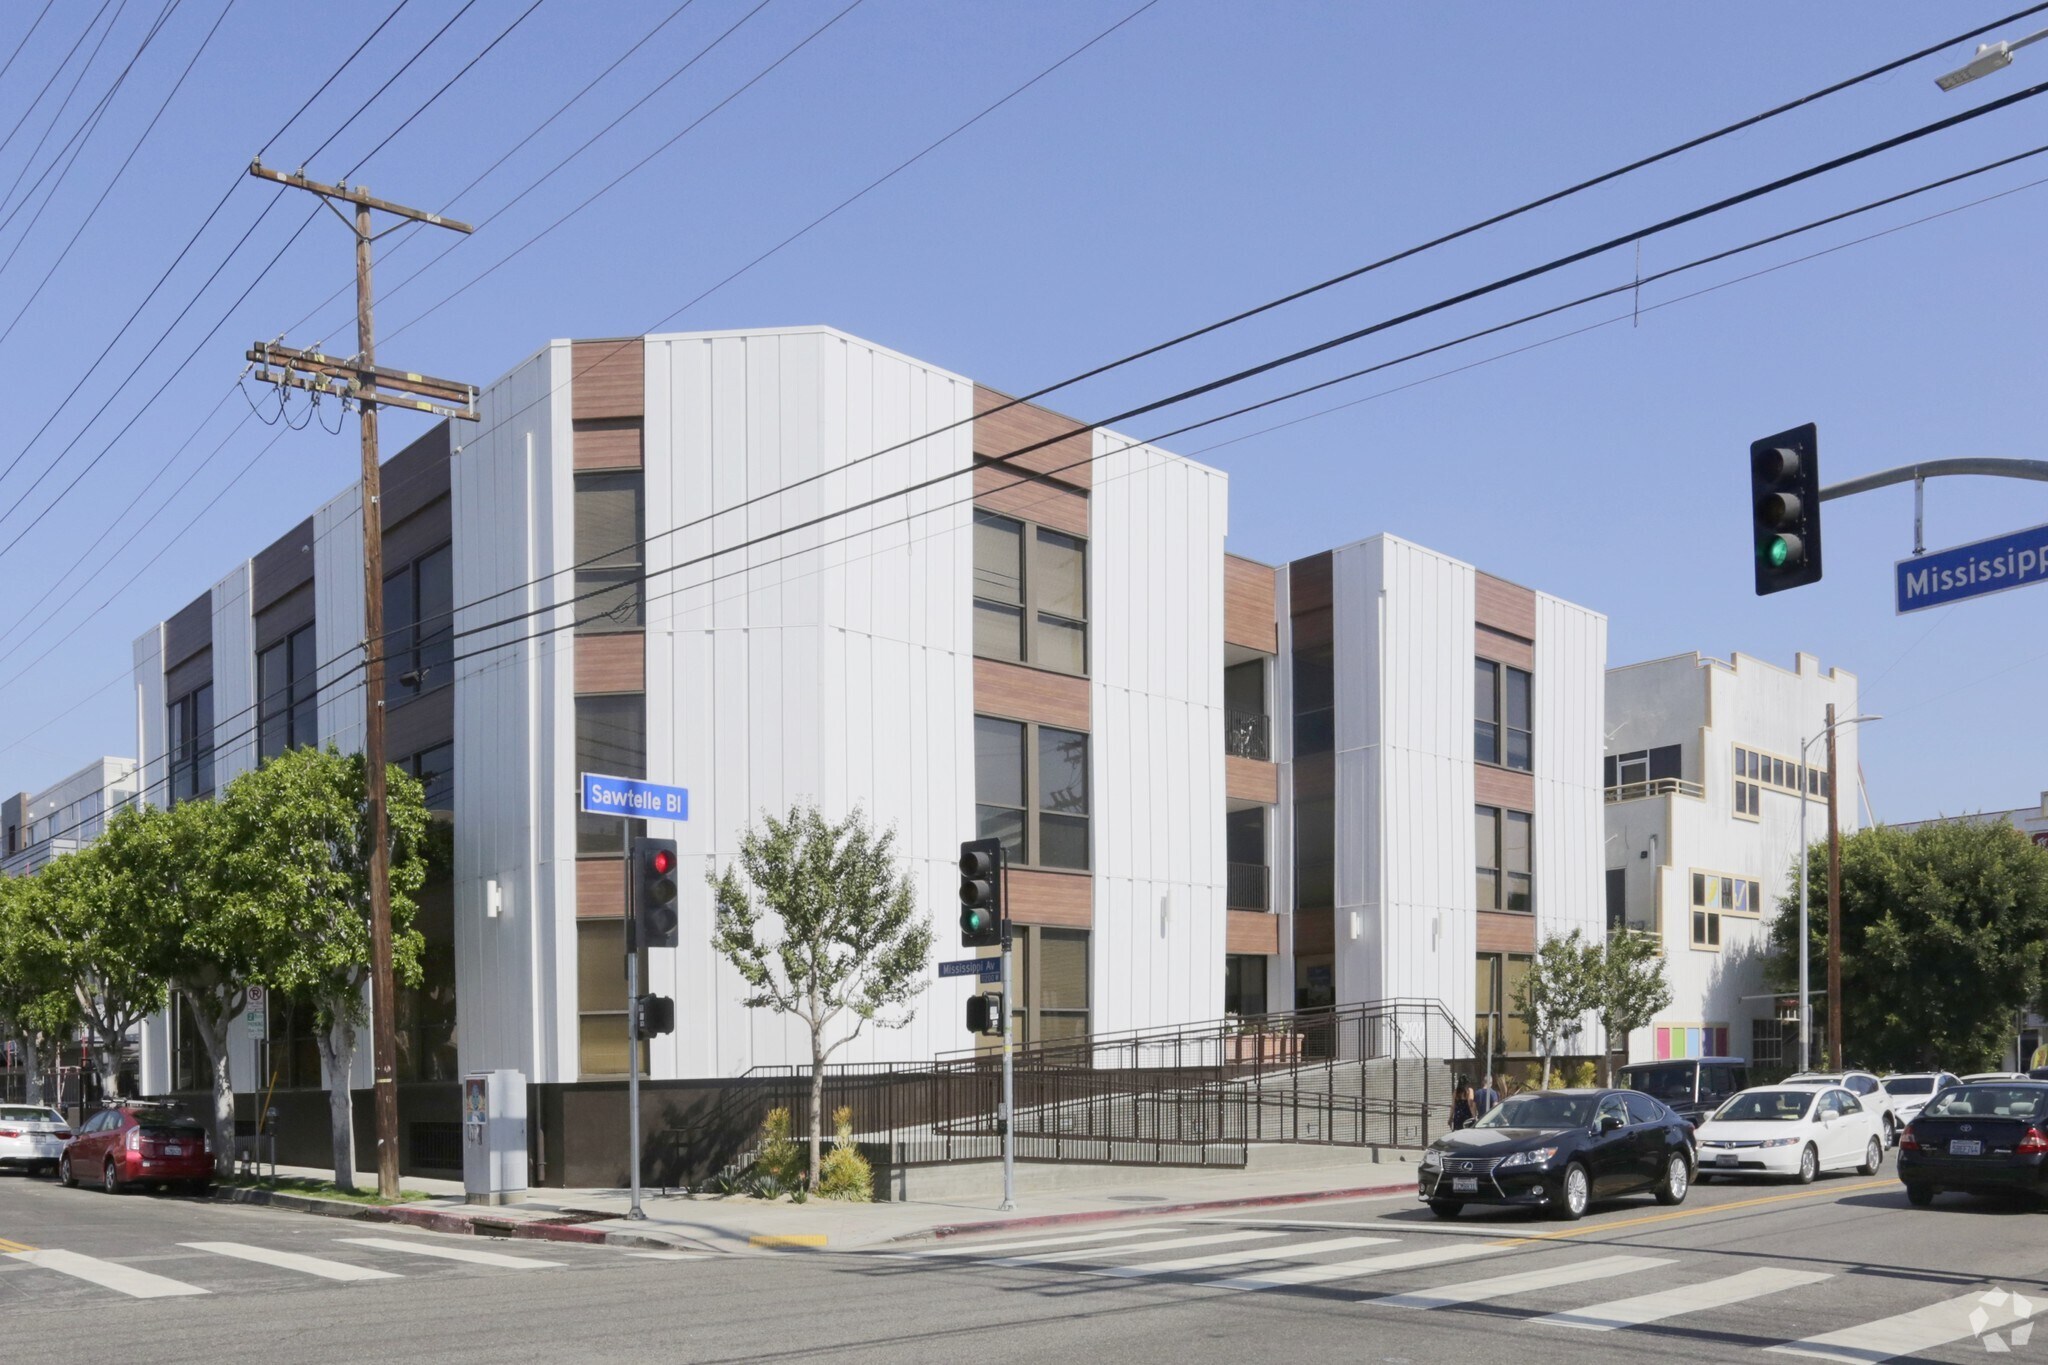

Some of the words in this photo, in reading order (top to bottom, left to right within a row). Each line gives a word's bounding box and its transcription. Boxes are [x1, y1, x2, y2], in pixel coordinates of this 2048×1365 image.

[592, 784, 661, 811] Sawtelle
[666, 793, 681, 813] Bl
[943, 960, 983, 975] Mississippi
[985, 960, 995, 971] Av
[1400, 1021, 1424, 1042] 2100
